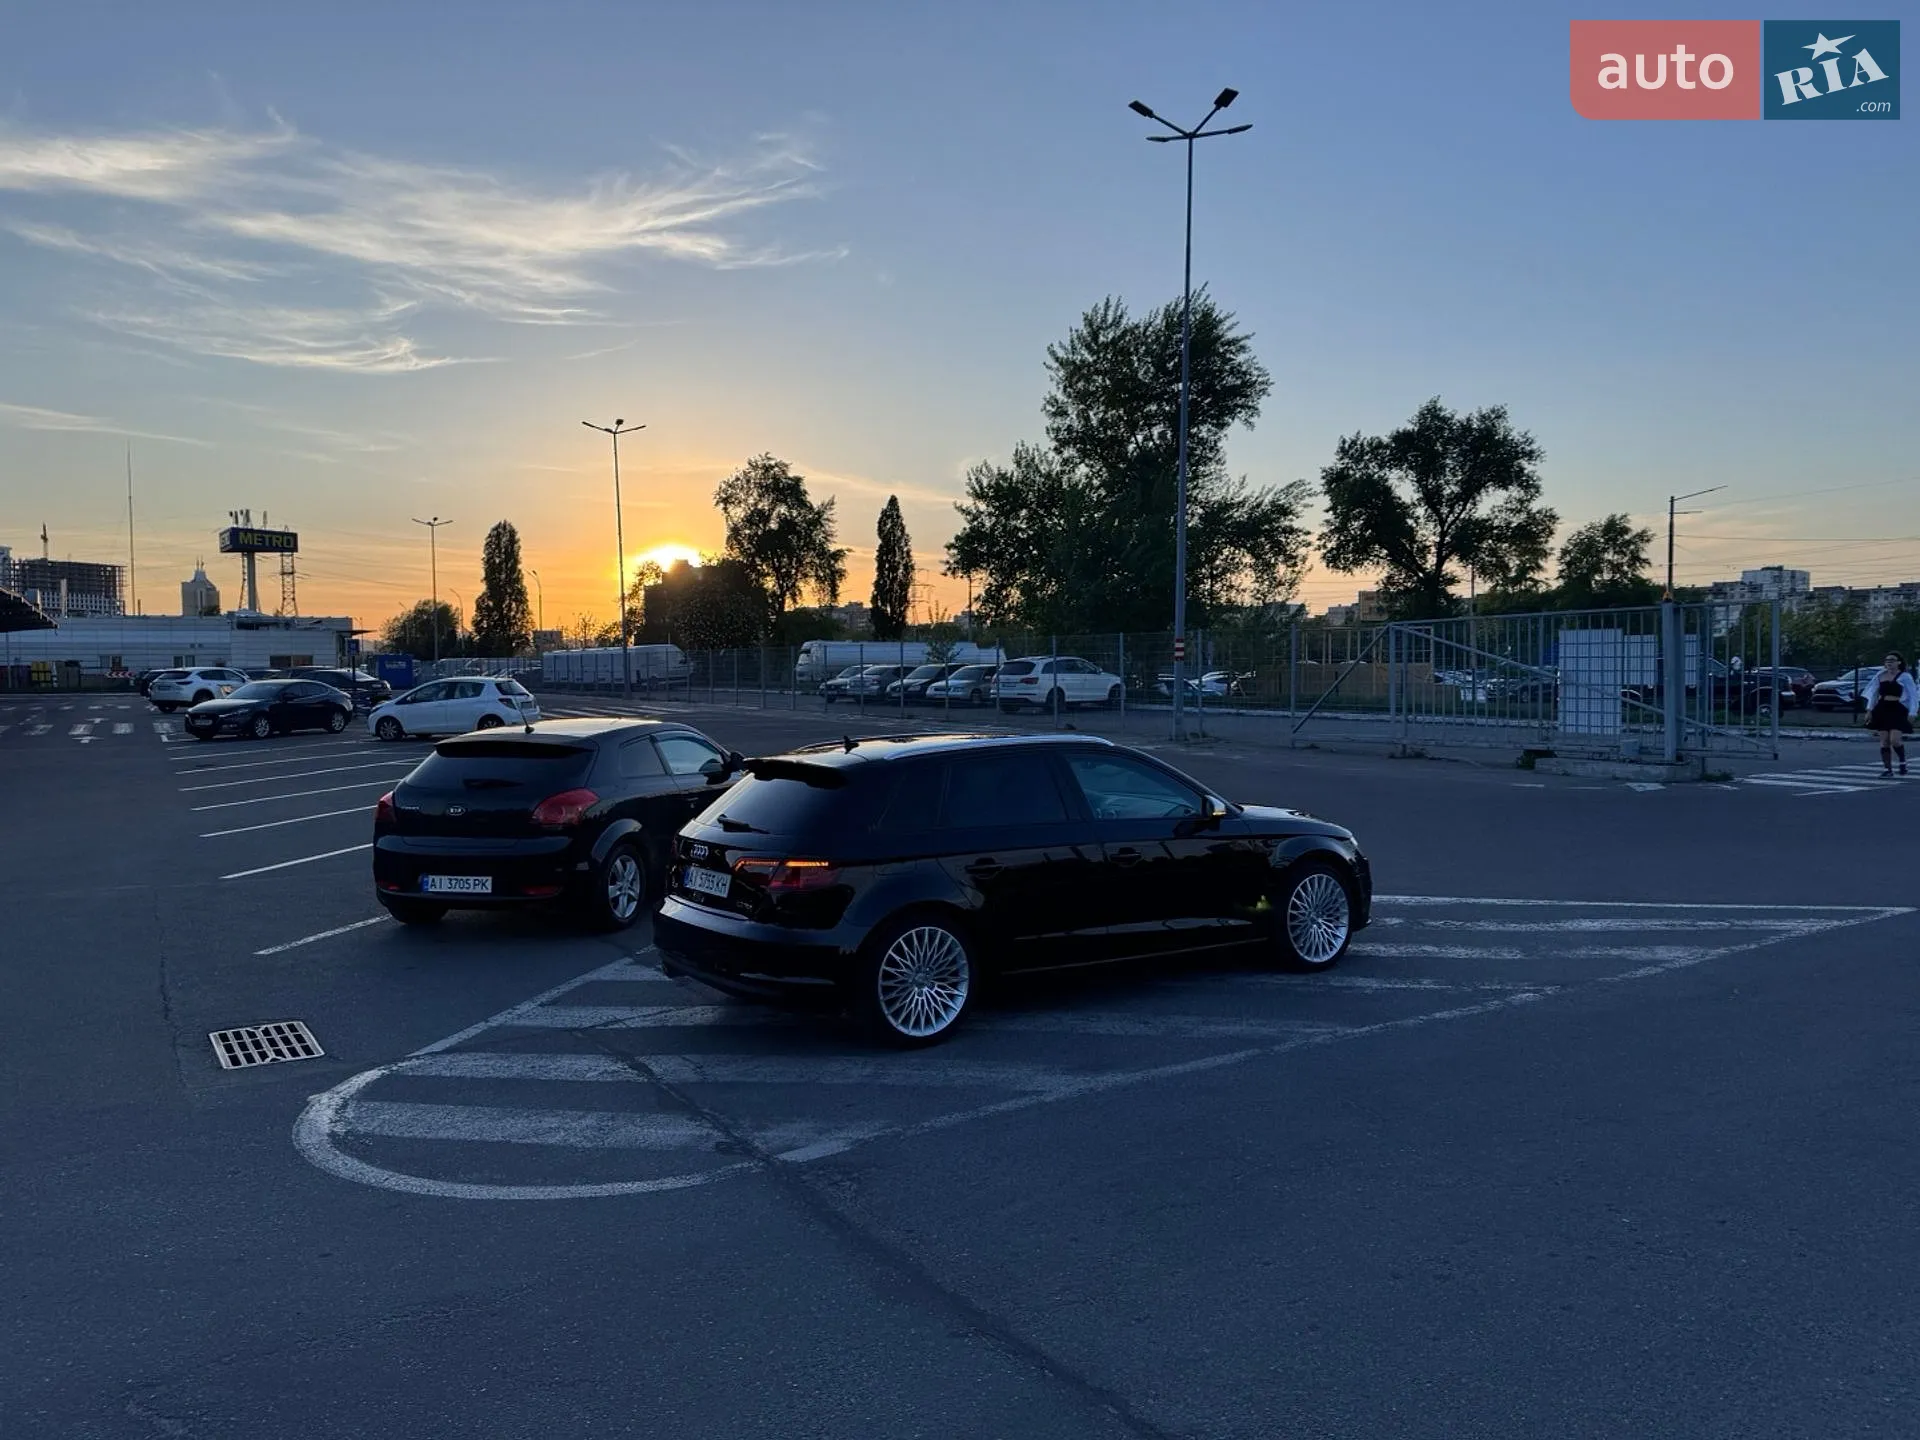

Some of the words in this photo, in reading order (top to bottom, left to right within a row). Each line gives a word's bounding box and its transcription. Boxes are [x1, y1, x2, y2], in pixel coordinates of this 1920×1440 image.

[239, 532, 295, 548] METRO
[430, 877, 443, 890] AI
[447, 877, 472, 890] 3705
[473, 878, 489, 891] PK
